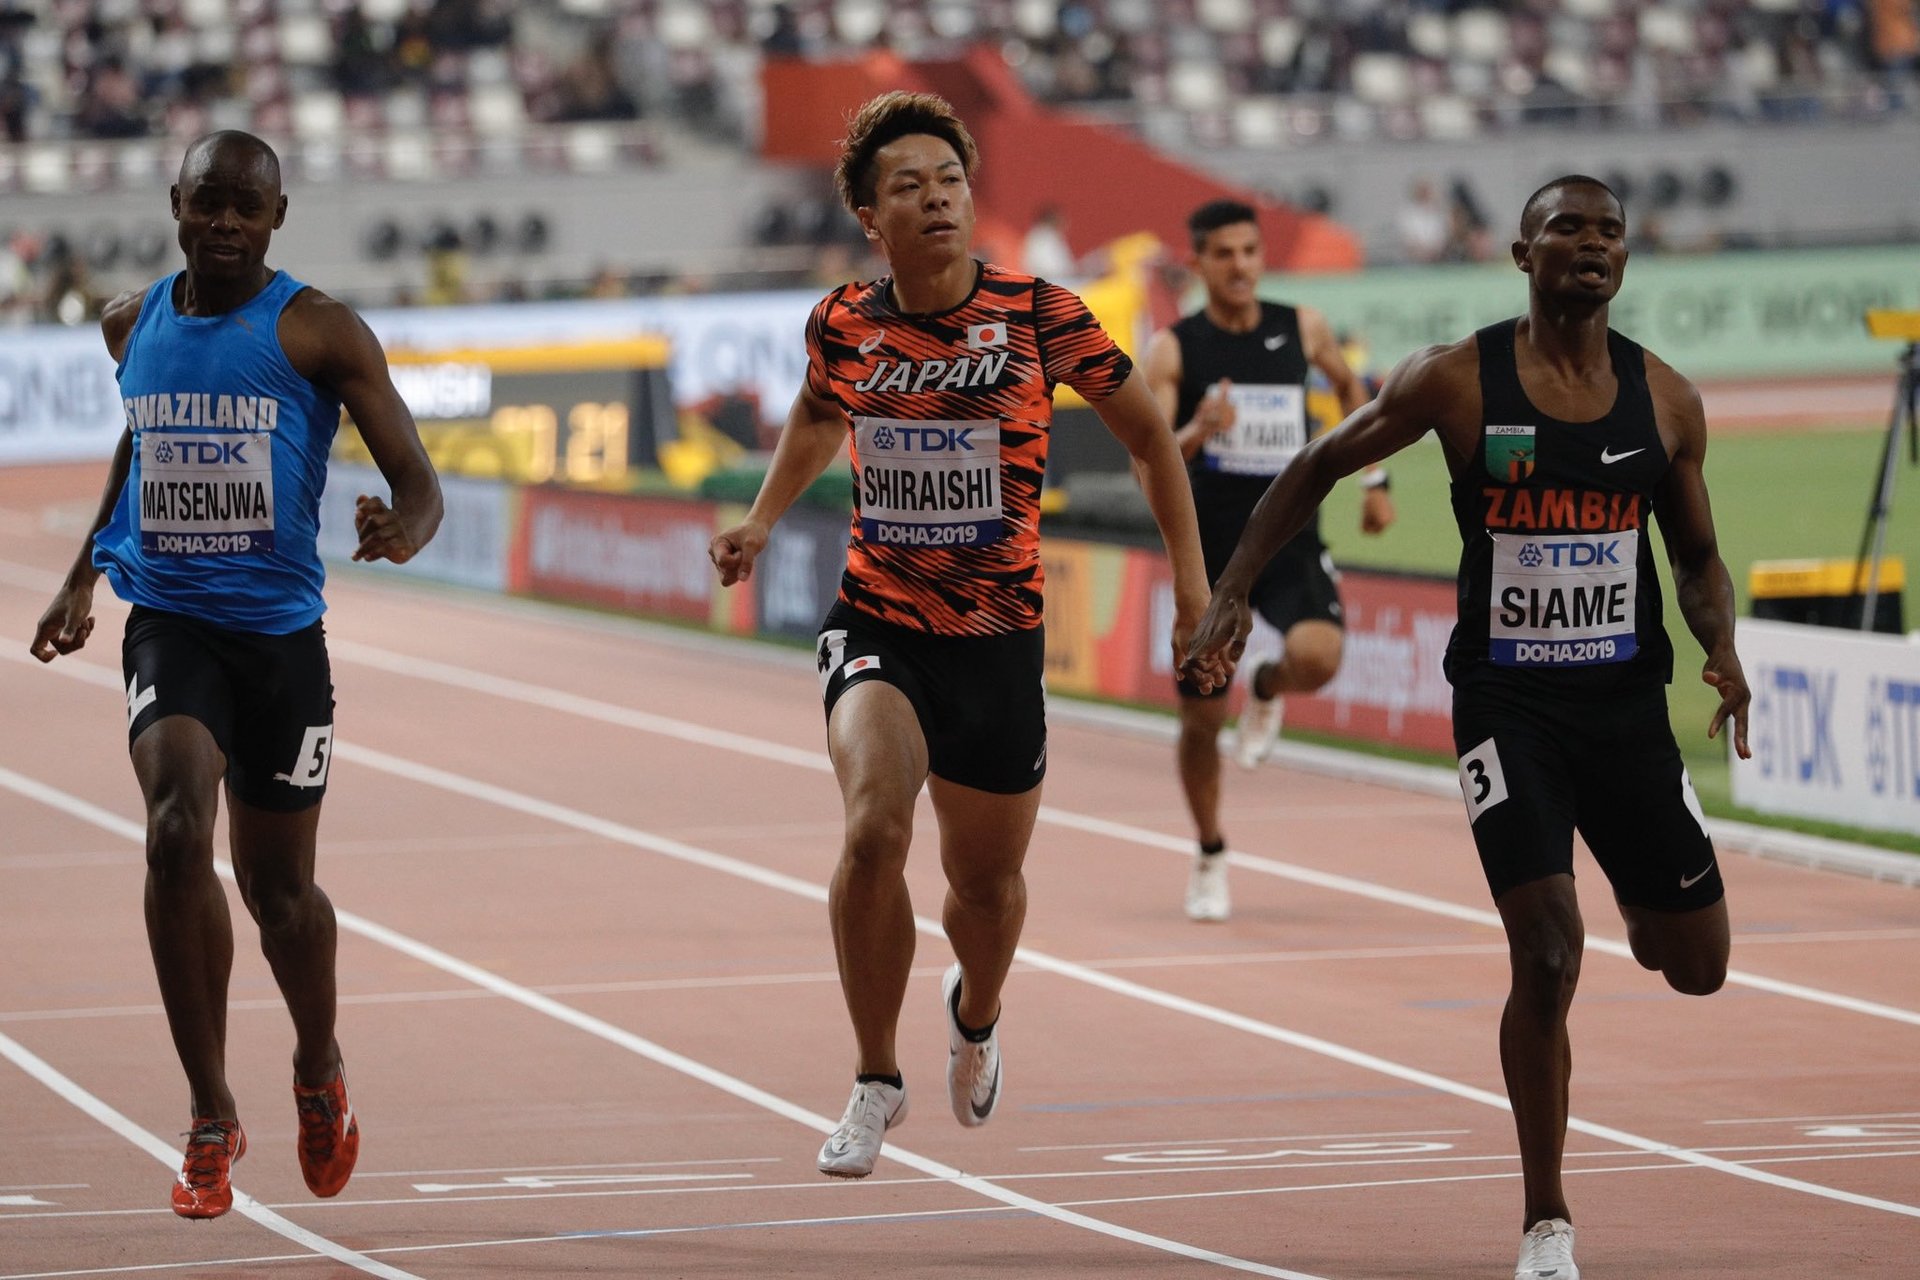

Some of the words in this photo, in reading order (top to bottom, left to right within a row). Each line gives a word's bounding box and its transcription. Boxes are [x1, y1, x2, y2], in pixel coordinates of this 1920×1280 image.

[855, 351, 1009, 393] JAPAN
[125, 392, 278, 432] SWAZILAND
[1495, 426, 1525, 435] ZAMBIA
[173, 441, 249, 465] TDK
[895, 426, 976, 452] TDK
[142, 480, 268, 522] MATSENJWA
[864, 465, 993, 512] SHIRAISHI
[1482, 487, 1641, 530] ZAMBIA
[156, 534, 251, 554] DOHA2019
[877, 523, 978, 545] DOHA2019
[1543, 540, 1621, 568] TDK
[1500, 582, 1628, 630] SIAME
[1515, 638, 1617, 663] DOHA2019
[308, 736, 327, 778] 5
[1466, 758, 1492, 805] 3
